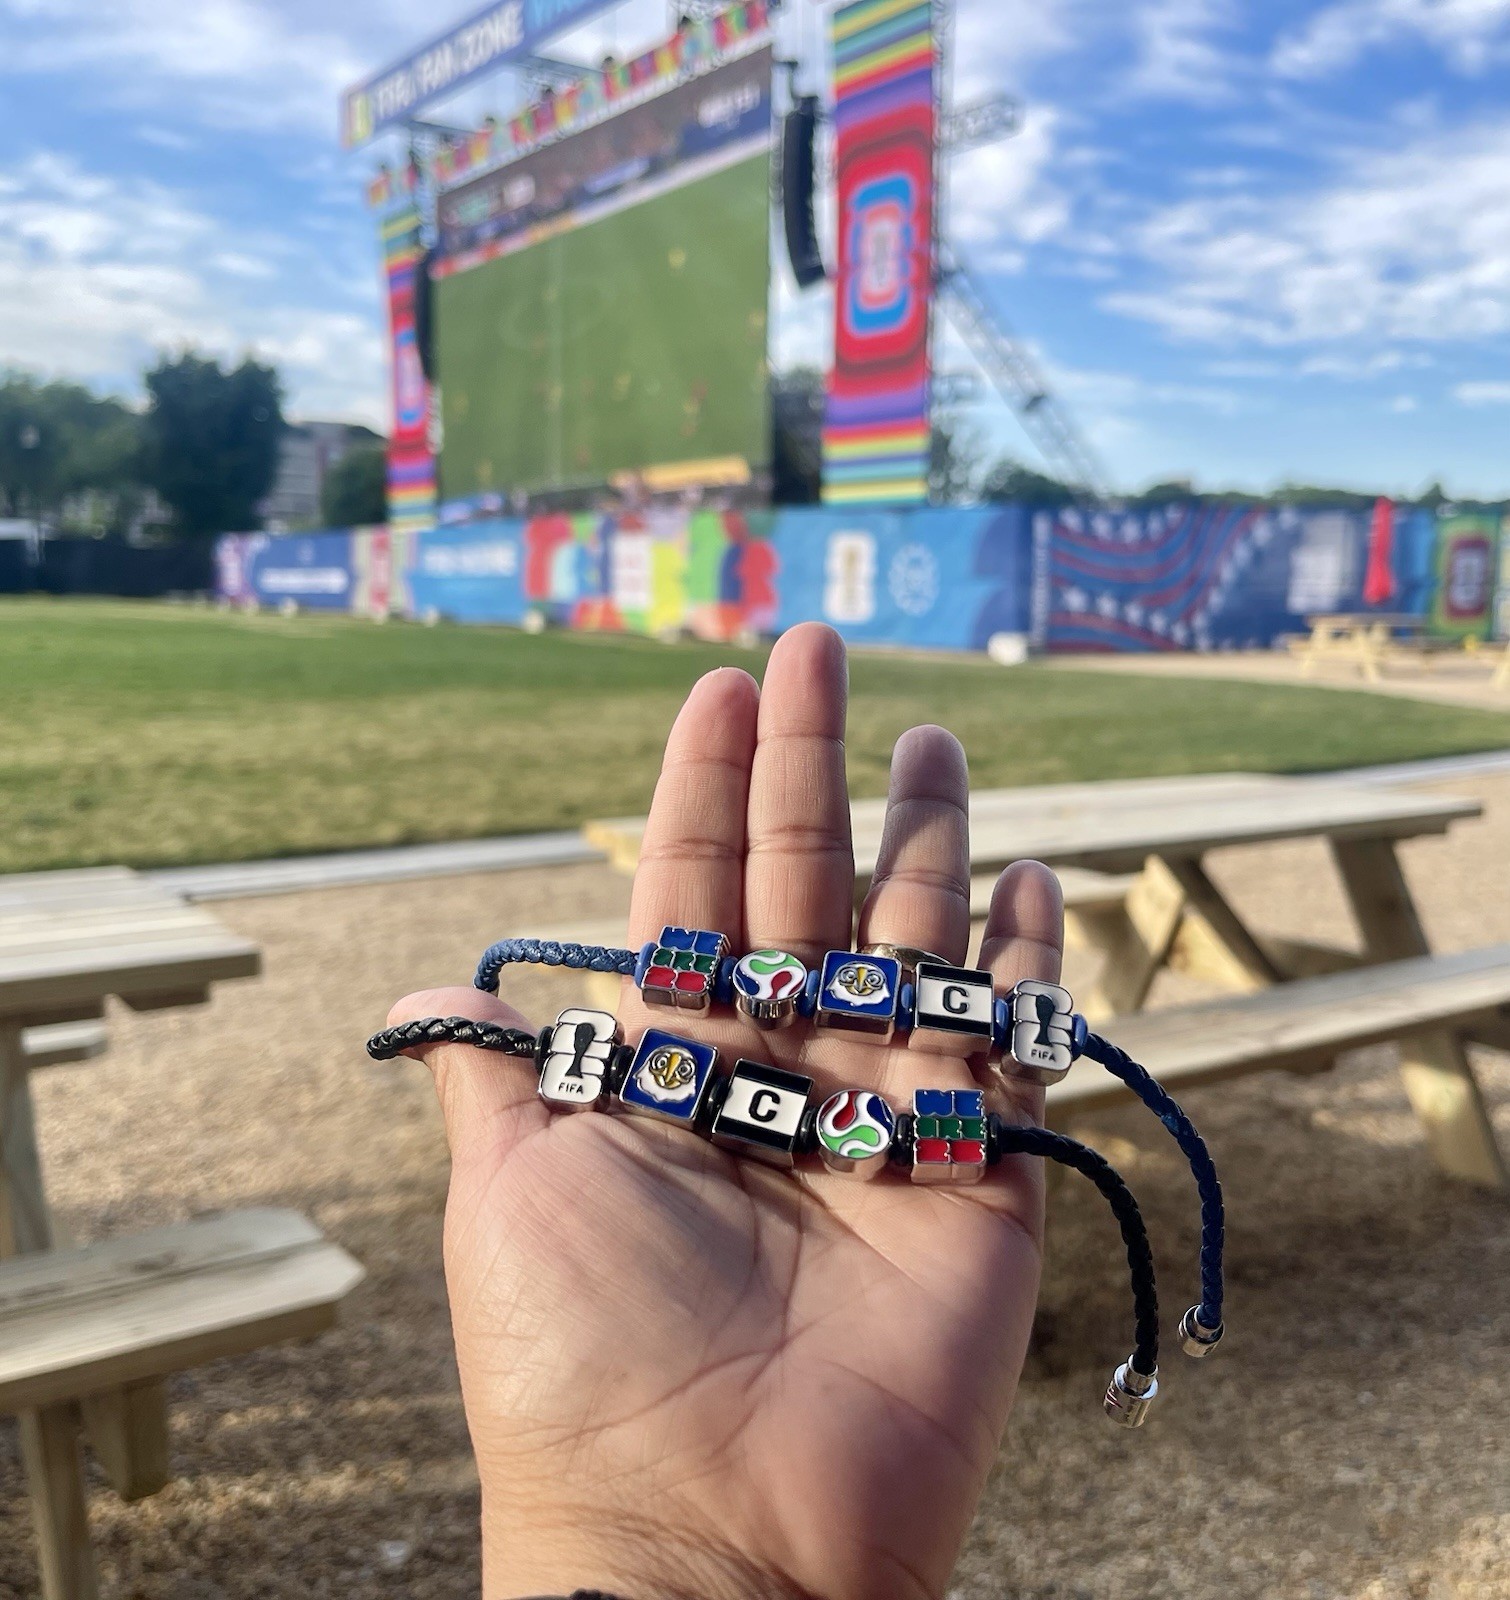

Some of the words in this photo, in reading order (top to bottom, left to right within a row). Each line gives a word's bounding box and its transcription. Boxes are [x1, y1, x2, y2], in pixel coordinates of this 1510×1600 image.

[942, 986, 969, 1015] C
[1030, 1049, 1056, 1063] FIFA
[557, 1081, 585, 1096] FIFA
[748, 1089, 781, 1122] C
